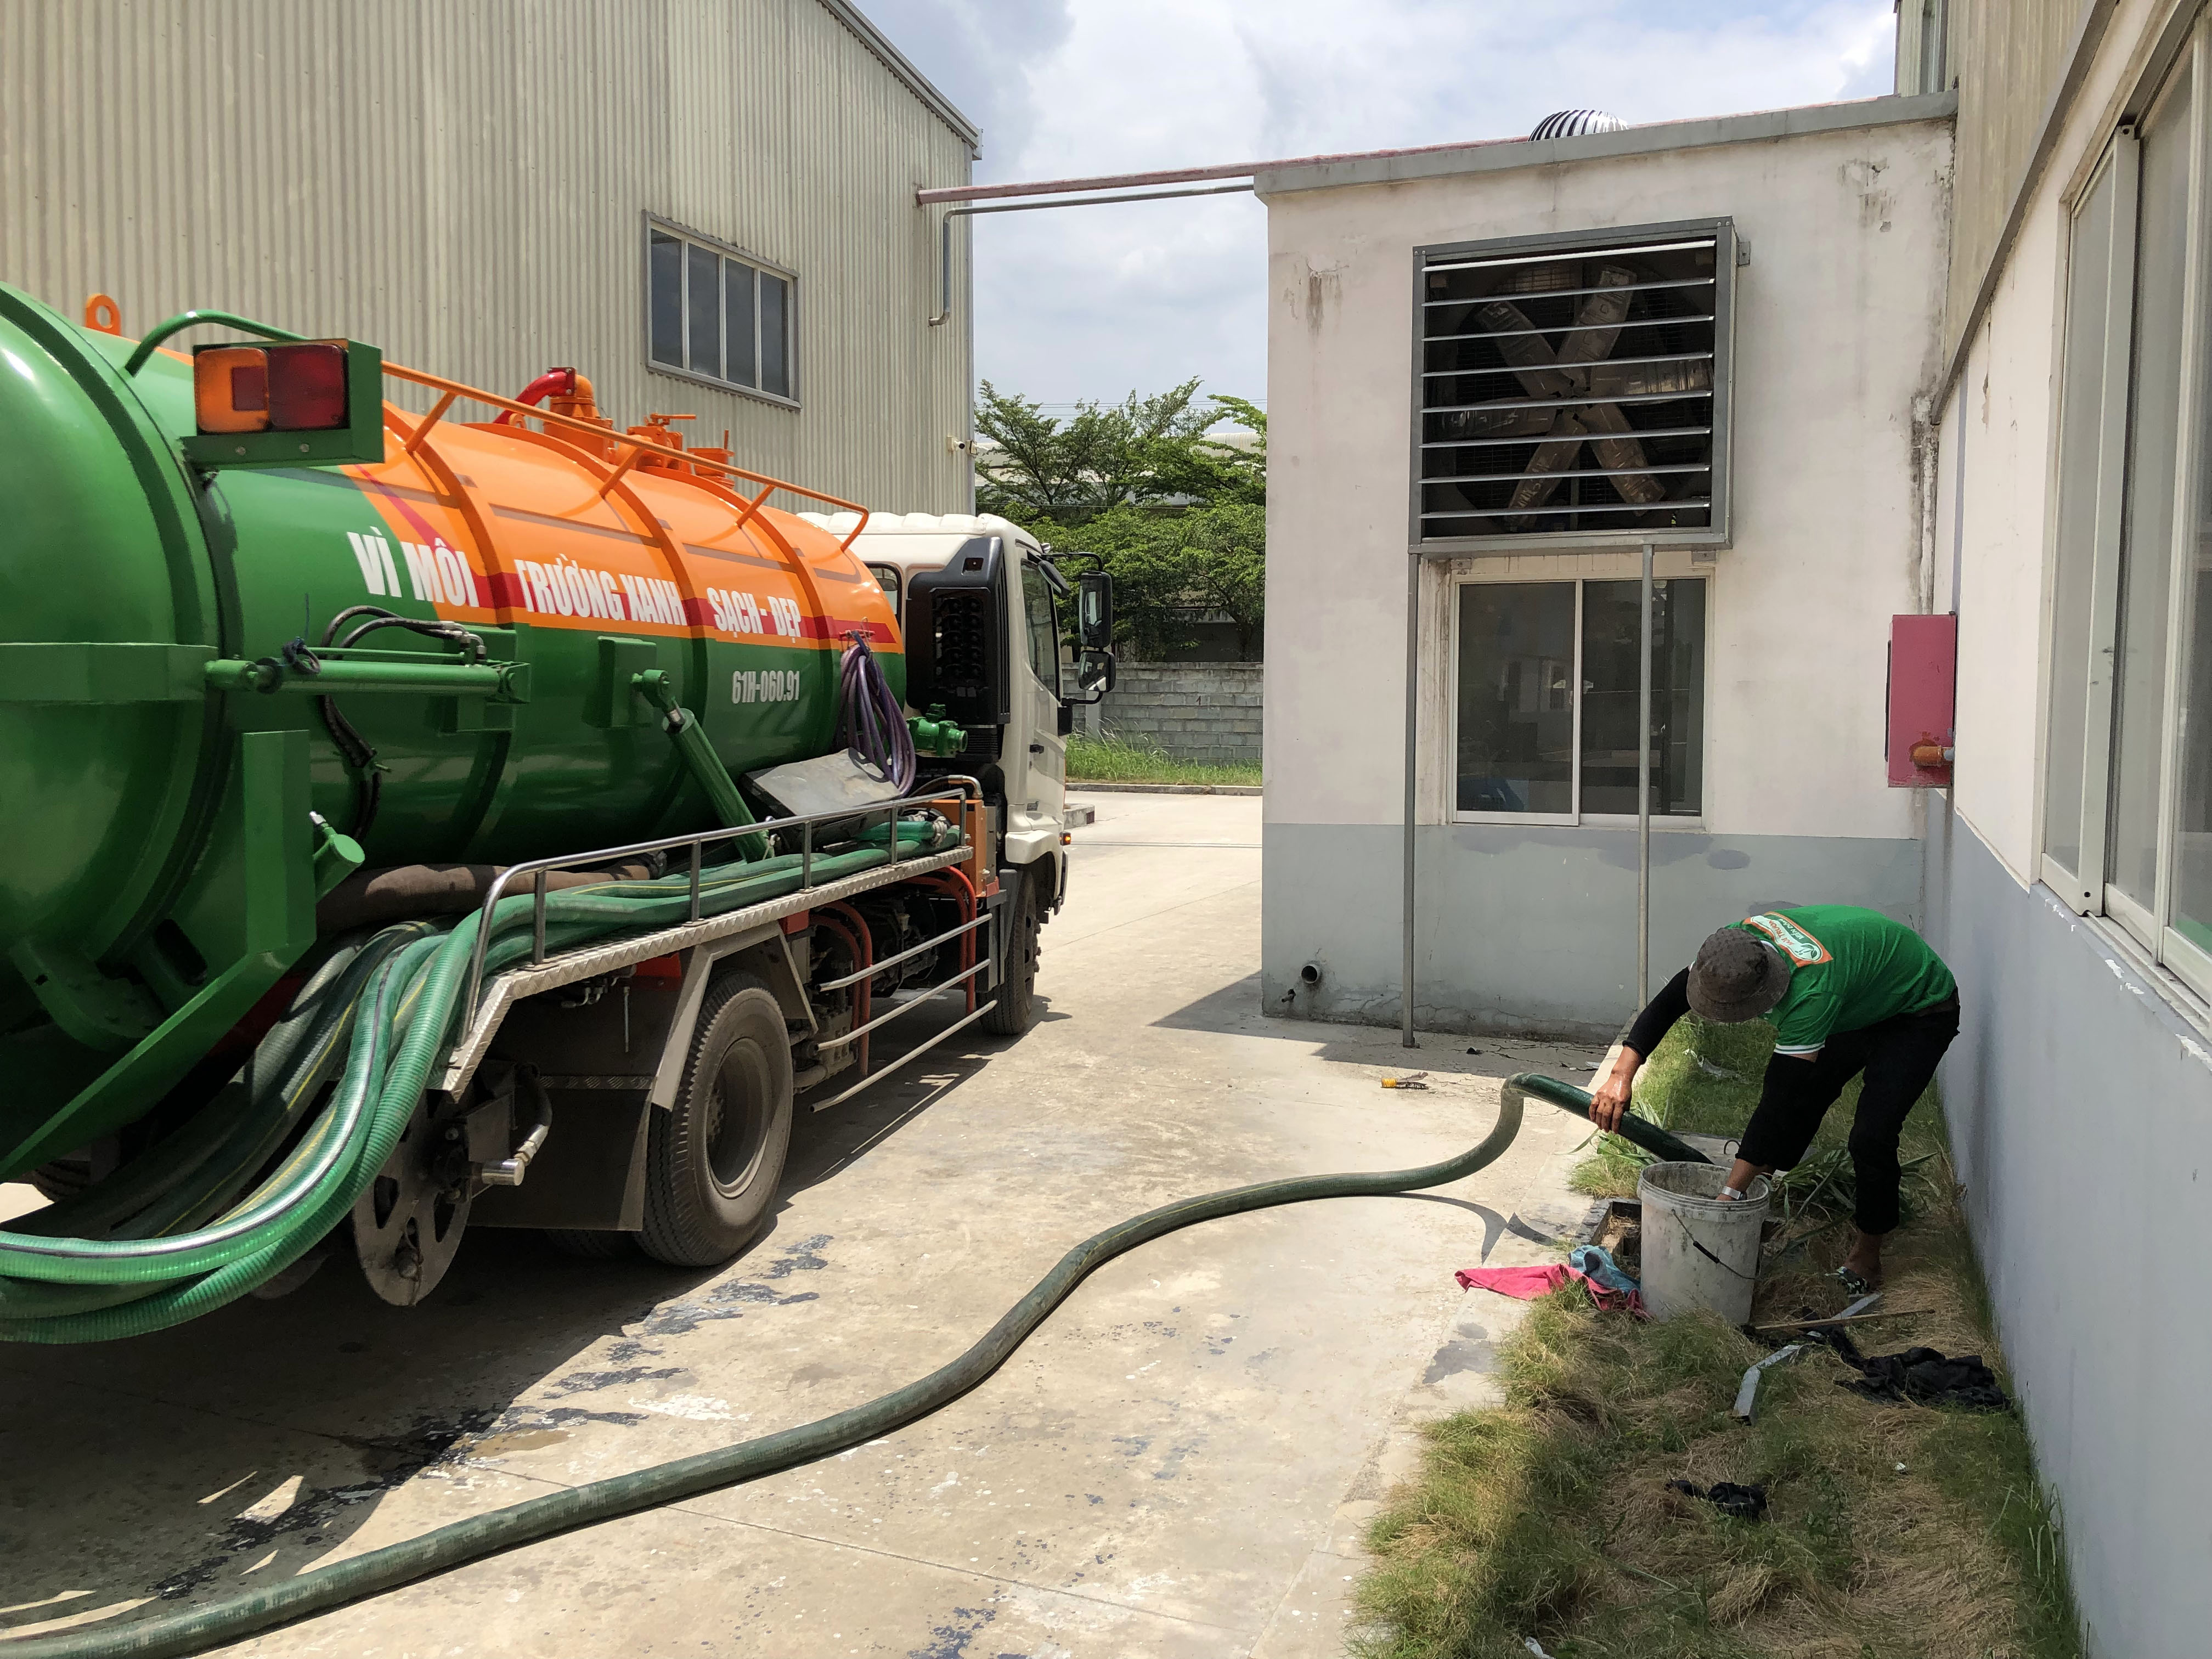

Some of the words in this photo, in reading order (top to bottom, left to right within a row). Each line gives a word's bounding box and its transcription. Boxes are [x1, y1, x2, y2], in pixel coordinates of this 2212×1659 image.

[347, 526, 402, 598] VÌ
[400, 537, 480, 607] MÔI
[514, 553, 626, 620] TRƯỜNG
[619, 574, 688, 626] XANH
[707, 587, 764, 638] SẠCH
[732, 670, 800, 704] 61H-060.91
